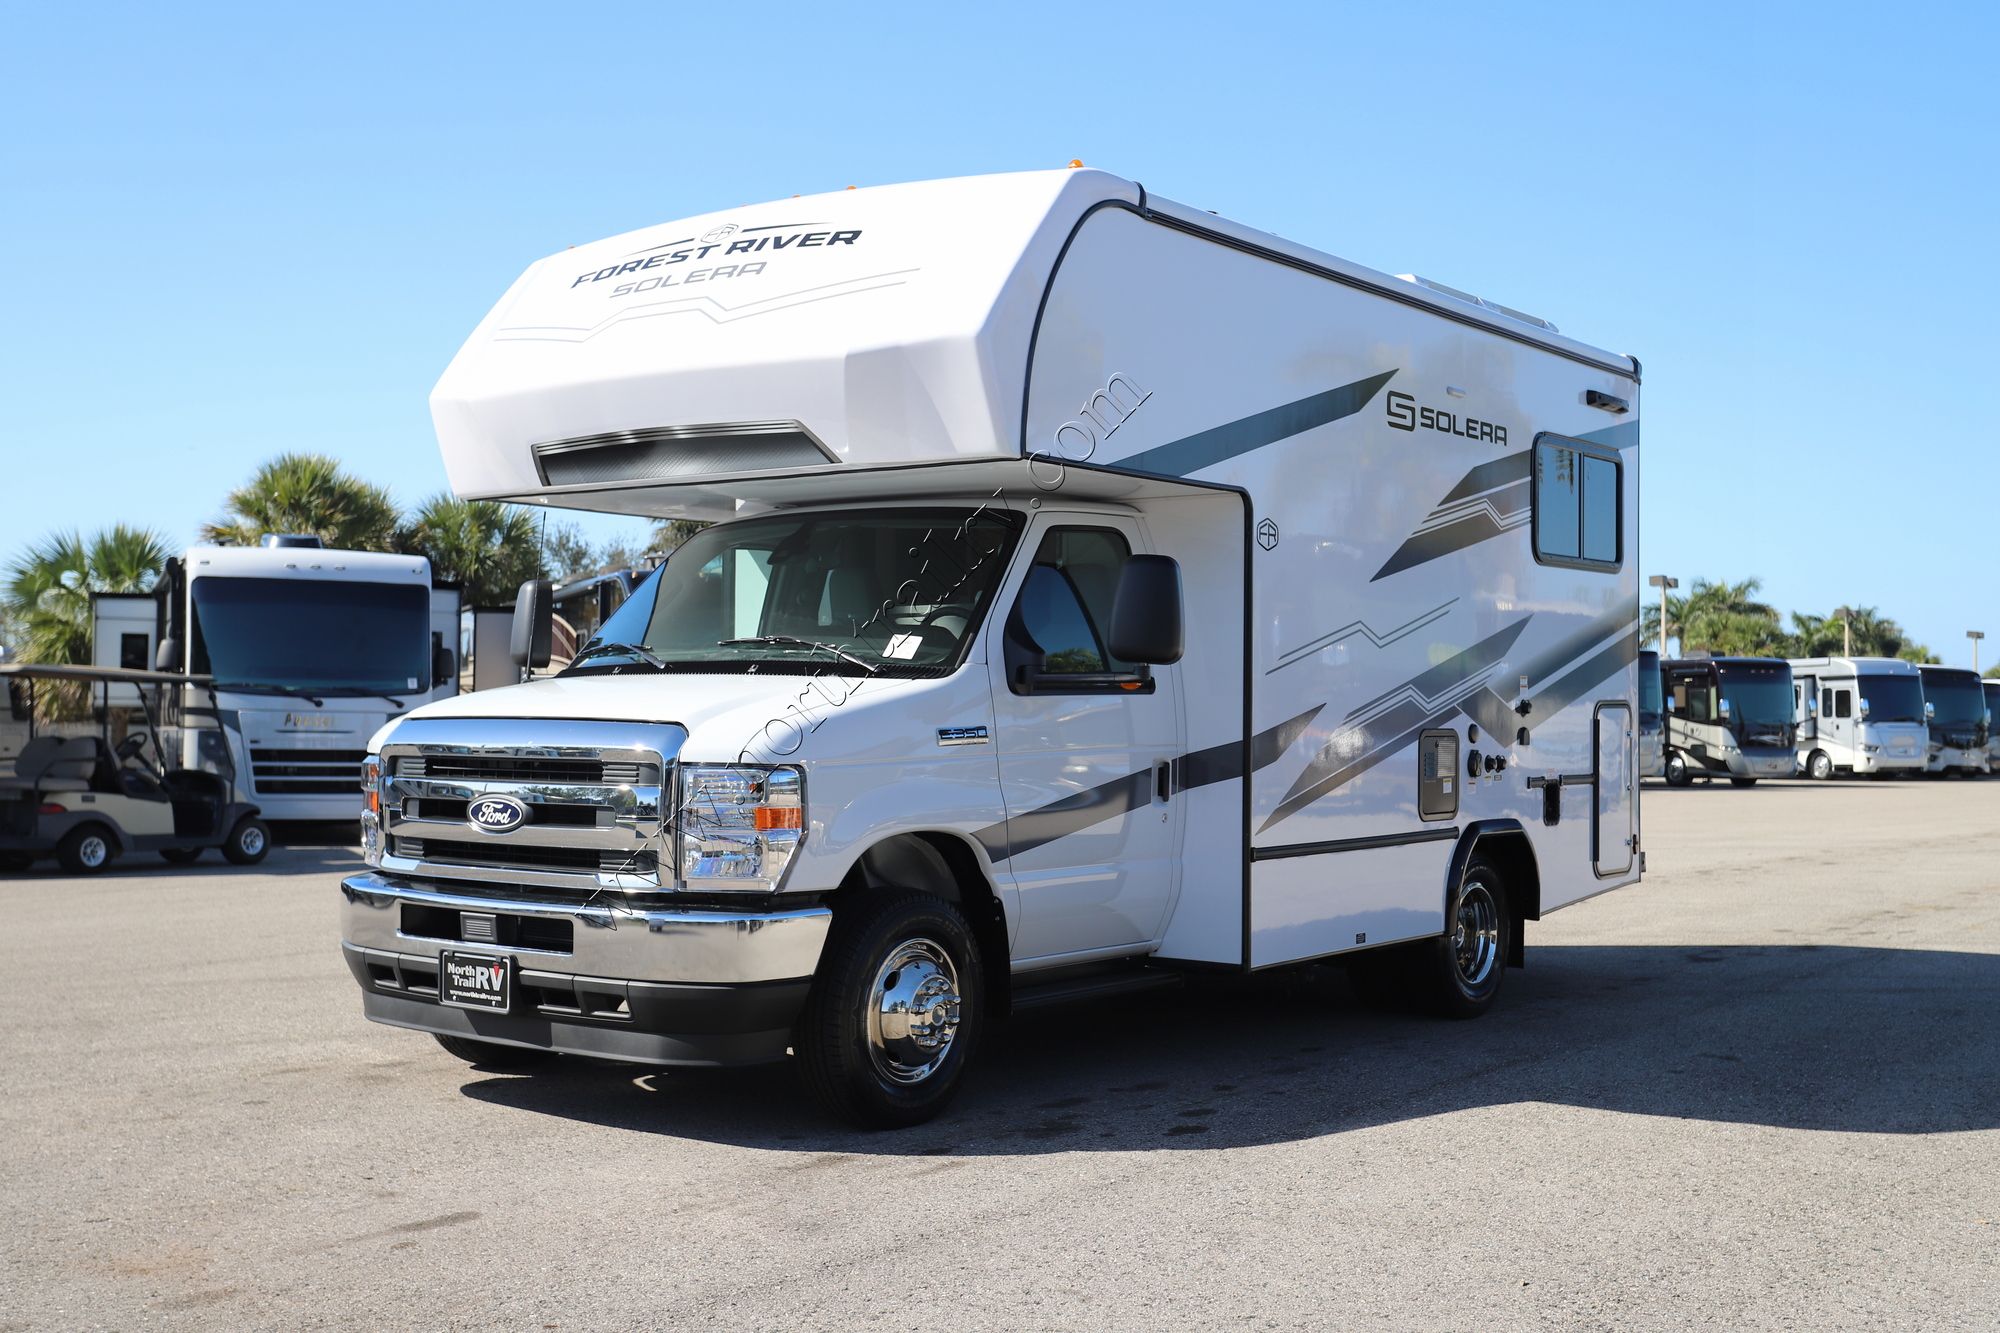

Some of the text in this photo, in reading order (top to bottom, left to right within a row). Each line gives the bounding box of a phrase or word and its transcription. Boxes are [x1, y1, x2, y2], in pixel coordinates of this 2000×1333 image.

[570, 230, 863, 289] FOREST RIVER
[609, 261, 767, 299] SOLERA
[1420, 406, 1507, 446] SOLERA
[478, 802, 512, 824] Ford
[447, 962, 475, 977] North
[452, 974, 475, 988] Trail
[475, 965, 504, 992] RV
